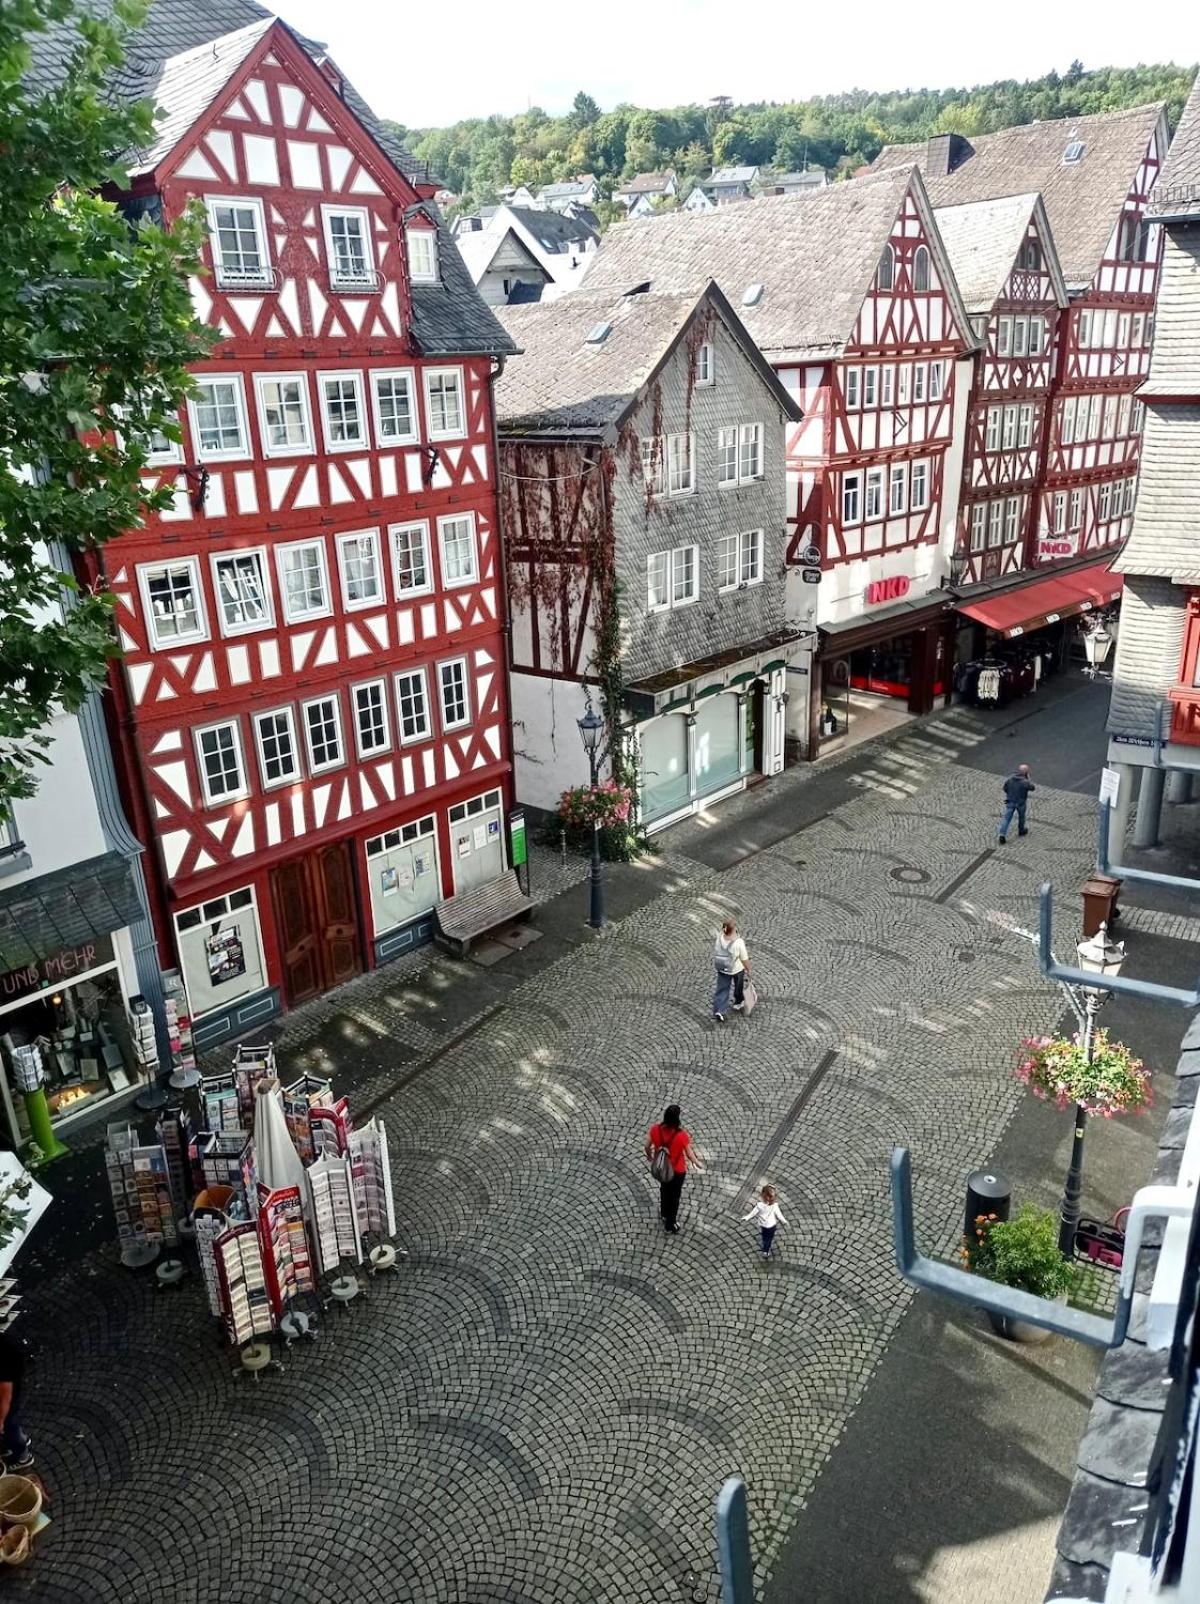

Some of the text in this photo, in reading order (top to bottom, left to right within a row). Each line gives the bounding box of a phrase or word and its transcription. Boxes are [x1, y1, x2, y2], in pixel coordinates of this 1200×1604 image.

[1041, 541, 1072, 554] NKD
[868, 575, 911, 604] NKD
[3, 944, 96, 994] UND MEHR
